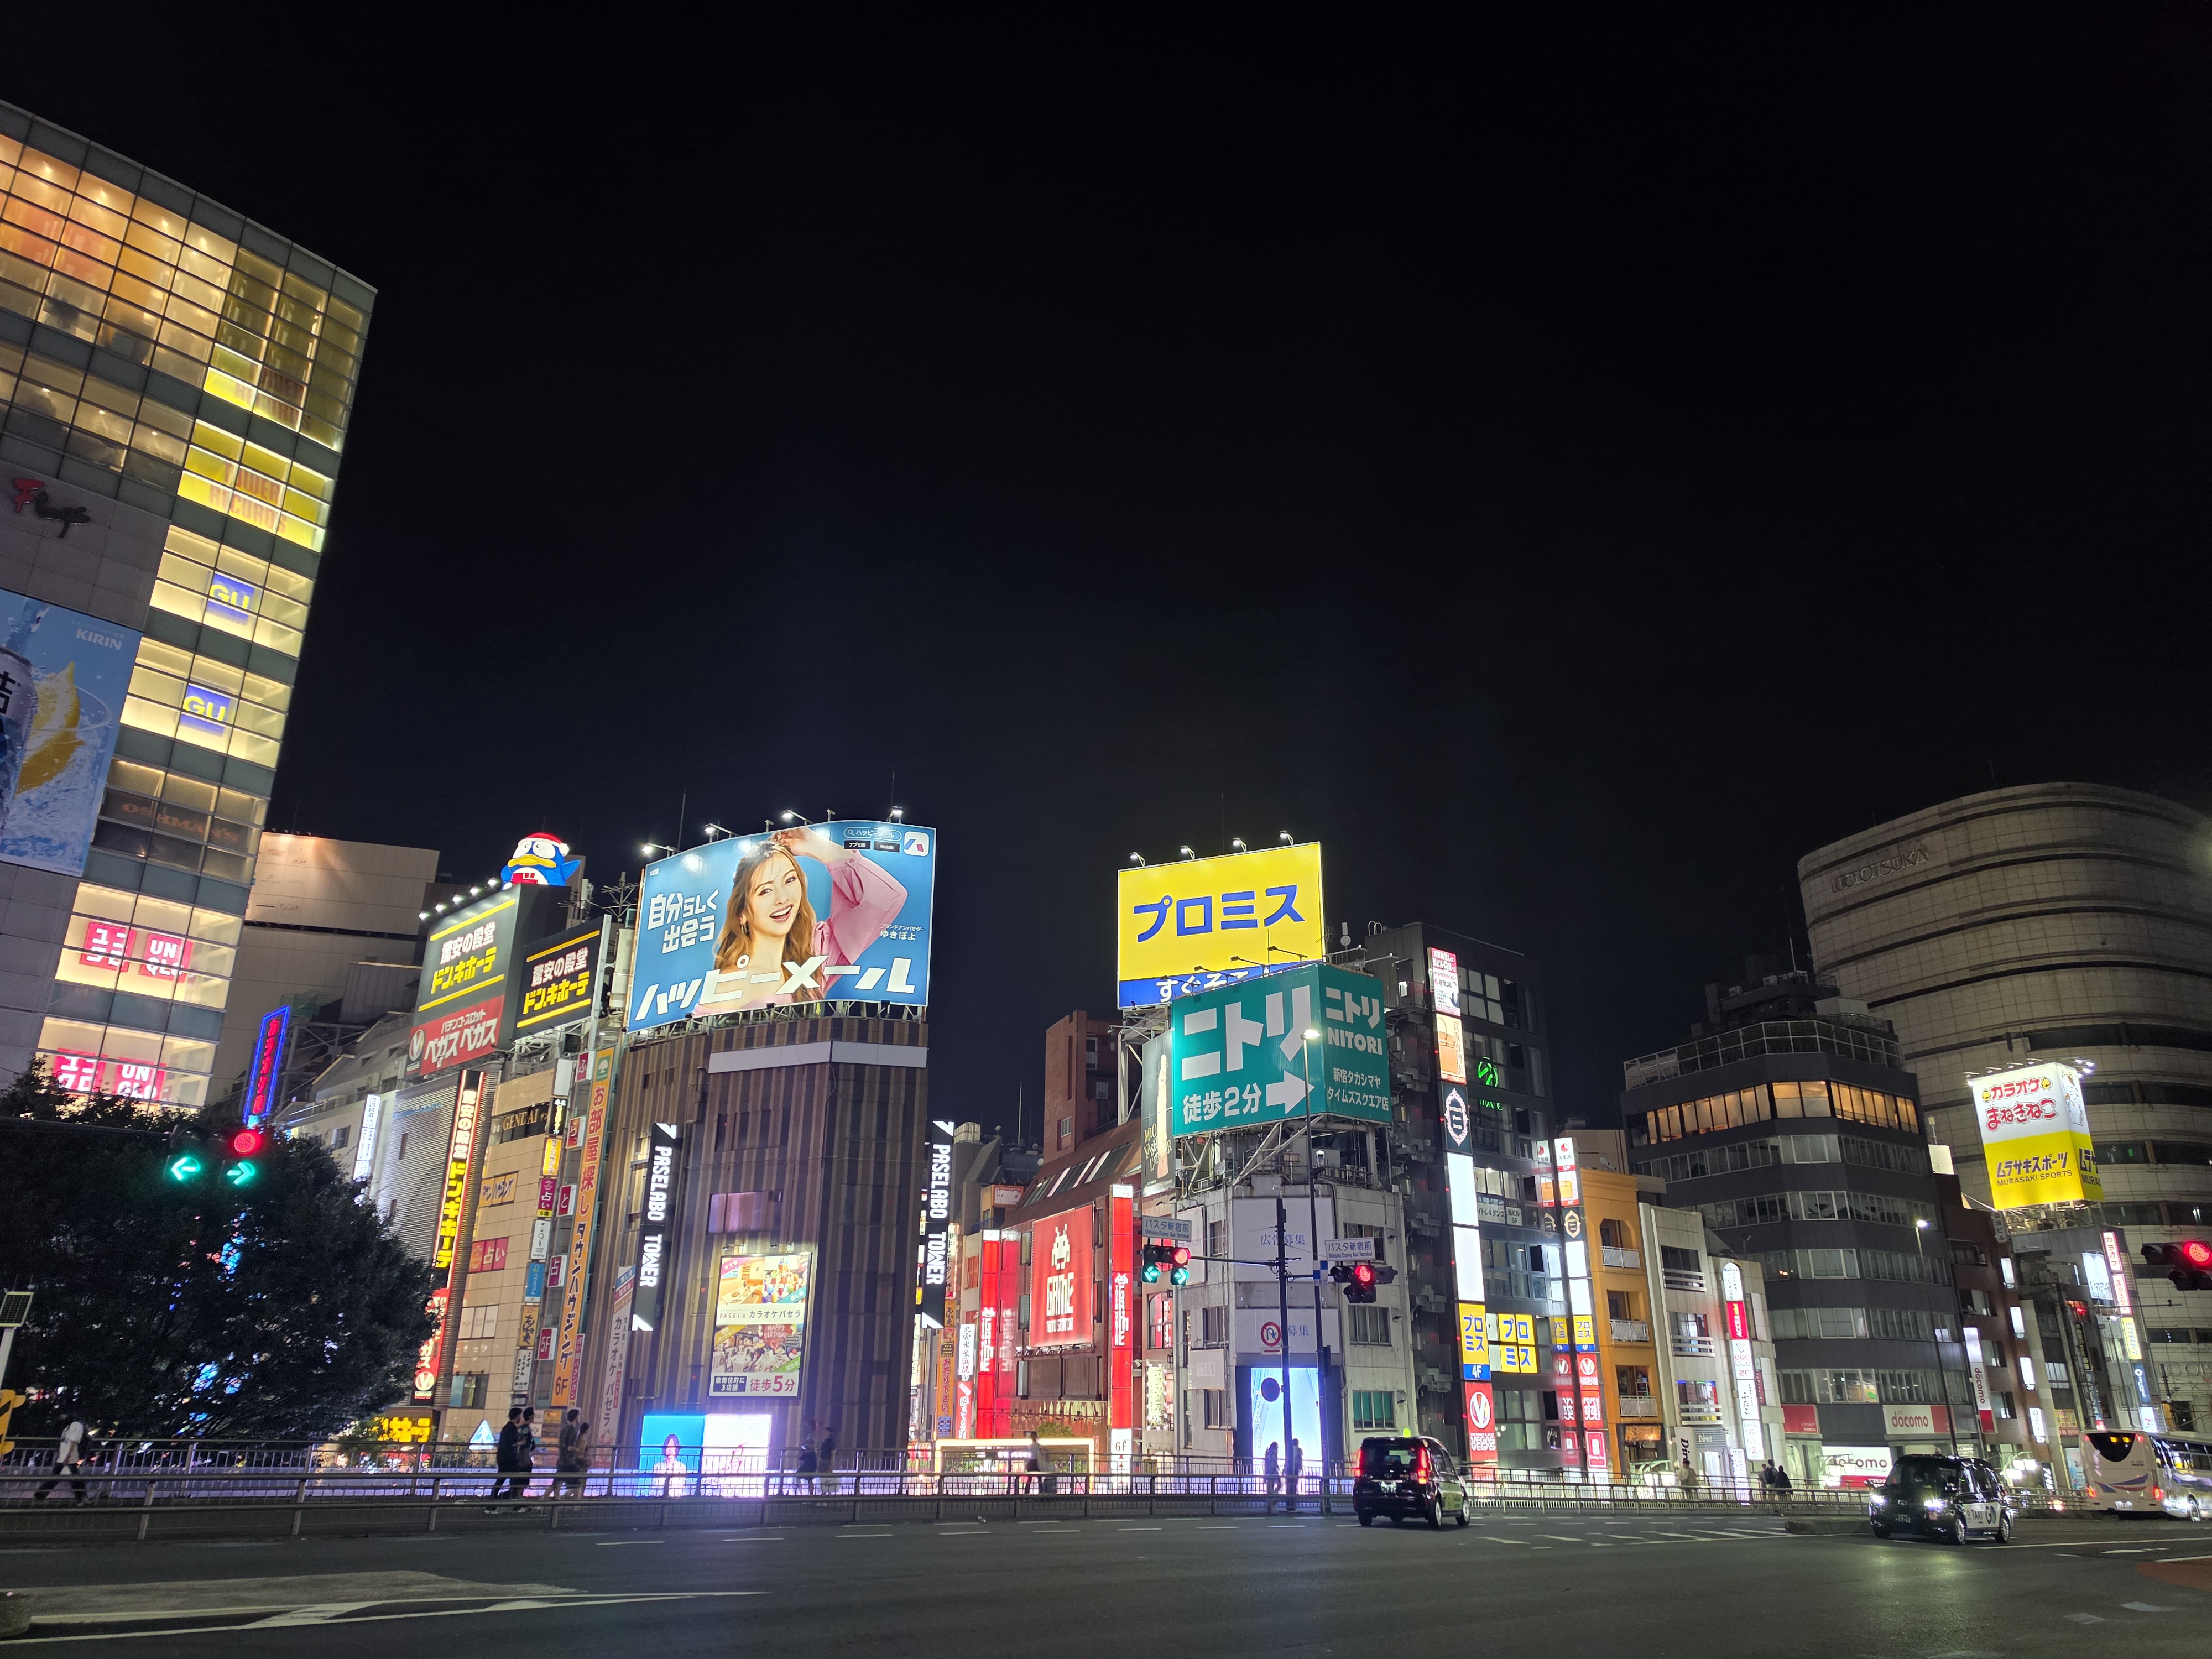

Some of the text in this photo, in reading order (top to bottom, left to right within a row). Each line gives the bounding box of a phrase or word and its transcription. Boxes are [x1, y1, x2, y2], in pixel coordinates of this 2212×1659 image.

[210, 583, 250, 611] GU
[75, 628, 122, 651] KIRIN
[183, 695, 227, 722] GU
[856, 830, 895, 838] ハッピーメール
[1860, 848, 1929, 882] OTSUKA
[648, 889, 719, 931] 自分らしく
[1133, 884, 1306, 944] プロミス
[440, 921, 496, 965] 驚安の殿堂
[662, 914, 715, 954] 出会う
[880, 930, 916, 941] ゆきぽよ
[150, 938, 178, 959] UN
[531, 947, 589, 987] 驚安の殿堂
[635, 954, 916, 1021] ハッピーメール
[1326, 986, 1381, 1029] ニトリ
[1181, 985, 1311, 1081] ニトリ
[1327, 1027, 1383, 1056] NITORI
[121, 1064, 150, 1081] UN
[578, 1058, 587, 1073] ふ
[1333, 1067, 1381, 1089] 新宿タカシマヤ
[1991, 1078, 2041, 1100] カラオケ
[1182, 1082, 1262, 1124] 徒歩2分
[1327, 1087, 1389, 1112] タイムズスクエア店
[452, 1089, 477, 1159] 驚安の殿堂
[503, 1108, 539, 1131] GENDAI
[1986, 1099, 2057, 1131] まねきねこ
[1144, 1123, 1157, 1144] MIO
[580, 1086, 606, 1216] お部屋探し
[1996, 1152, 2068, 1178] ムラサキスポーツ
[929, 1144, 951, 1219] PASELABO
[1997, 1170, 2073, 1187] MURASAKI SPORTS
[541, 1191, 554, 1209] 占い
[560, 1196, 569, 1209] と
[639, 1145, 673, 1287] PASELABO TOWER
[1145, 1219, 1190, 1233] バスタ新宿前
[483, 1246, 505, 1265] 占い
[1328, 1241, 1372, 1252] バスタ新宿前
[2106, 1237, 2117, 1266] カラオケ
[926, 1231, 946, 1285] TOWER
[550, 1258, 560, 1285] 占い
[558, 1222, 587, 1371] タウンハウジング
[1047, 1272, 1074, 1317] GAME
[748, 1309, 802, 1320] カラオケパセラ
[1463, 1314, 1484, 1333] プロ
[1577, 1321, 1590, 1329] プロ
[1046, 1320, 1057, 1333] TAITO
[1503, 1319, 1529, 1339] プロ
[540, 1335, 551, 1353] 5F
[1465, 1334, 1485, 1352] ミス
[1506, 1348, 1531, 1366] ミス
[603, 1316, 622, 1427] カラオケ パセラ
[1471, 1364, 1482, 1378] 4F
[555, 1376, 569, 1396] 6F
[749, 1375, 796, 1392] 徒歩5分
[1974, 1366, 1986, 1405] docomo
[1892, 1411, 1929, 1428] docomo
[1115, 1441, 1128, 1451] 6F
[1471, 1443, 1496, 1451] VEGAS
[1971, 1509, 1983, 1520] TAXI
[1985, 1505, 1996, 1524] GO
